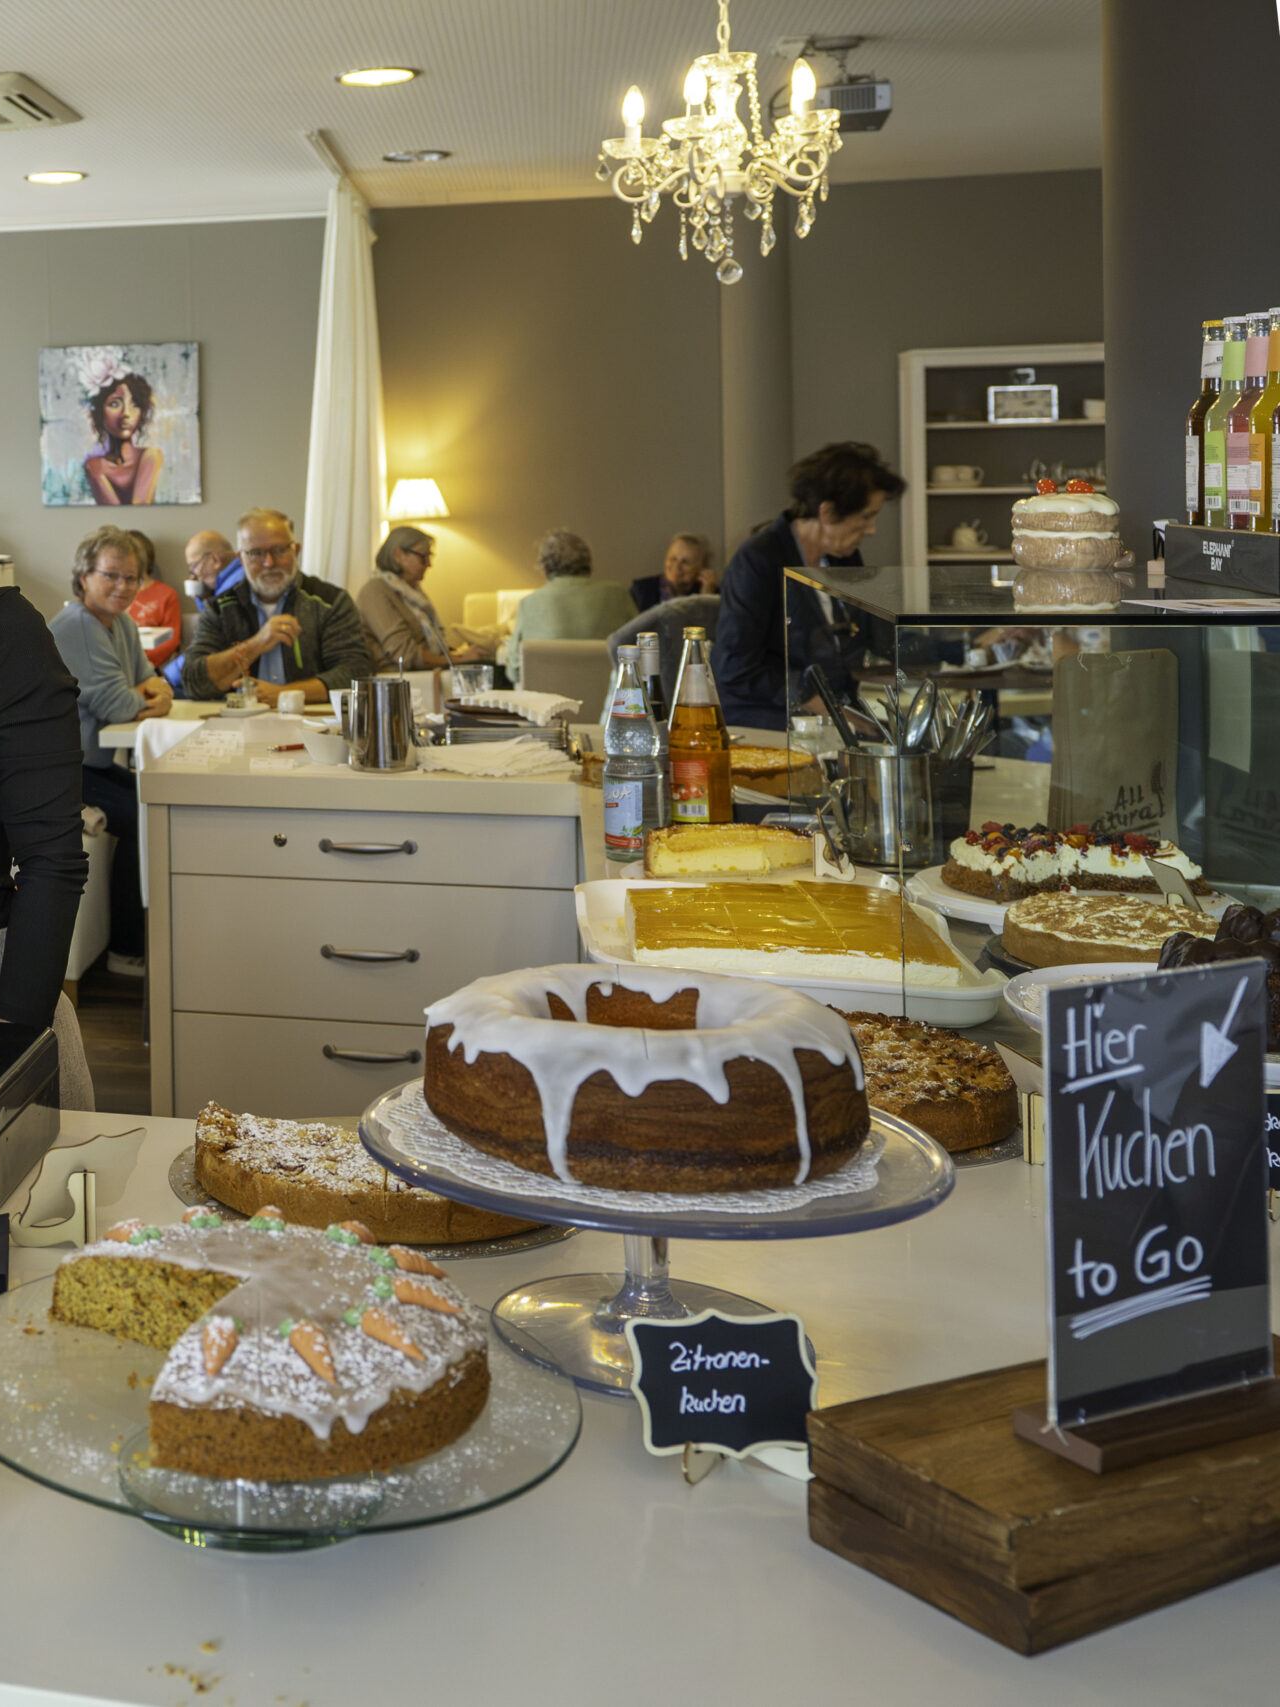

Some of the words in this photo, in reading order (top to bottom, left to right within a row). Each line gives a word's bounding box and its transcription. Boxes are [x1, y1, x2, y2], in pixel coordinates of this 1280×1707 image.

[1202, 540, 1232, 558] ELEPHANT
[1210, 557, 1222, 571] BAY
[1062, 1003, 1147, 1080] Hier
[1077, 1086, 1216, 1200] Kuchen
[1067, 1237, 1118, 1299] to
[1134, 1224, 1204, 1285] Go
[668, 1341, 771, 1373] Zitronen-
[679, 1385, 747, 1415] kuchen
